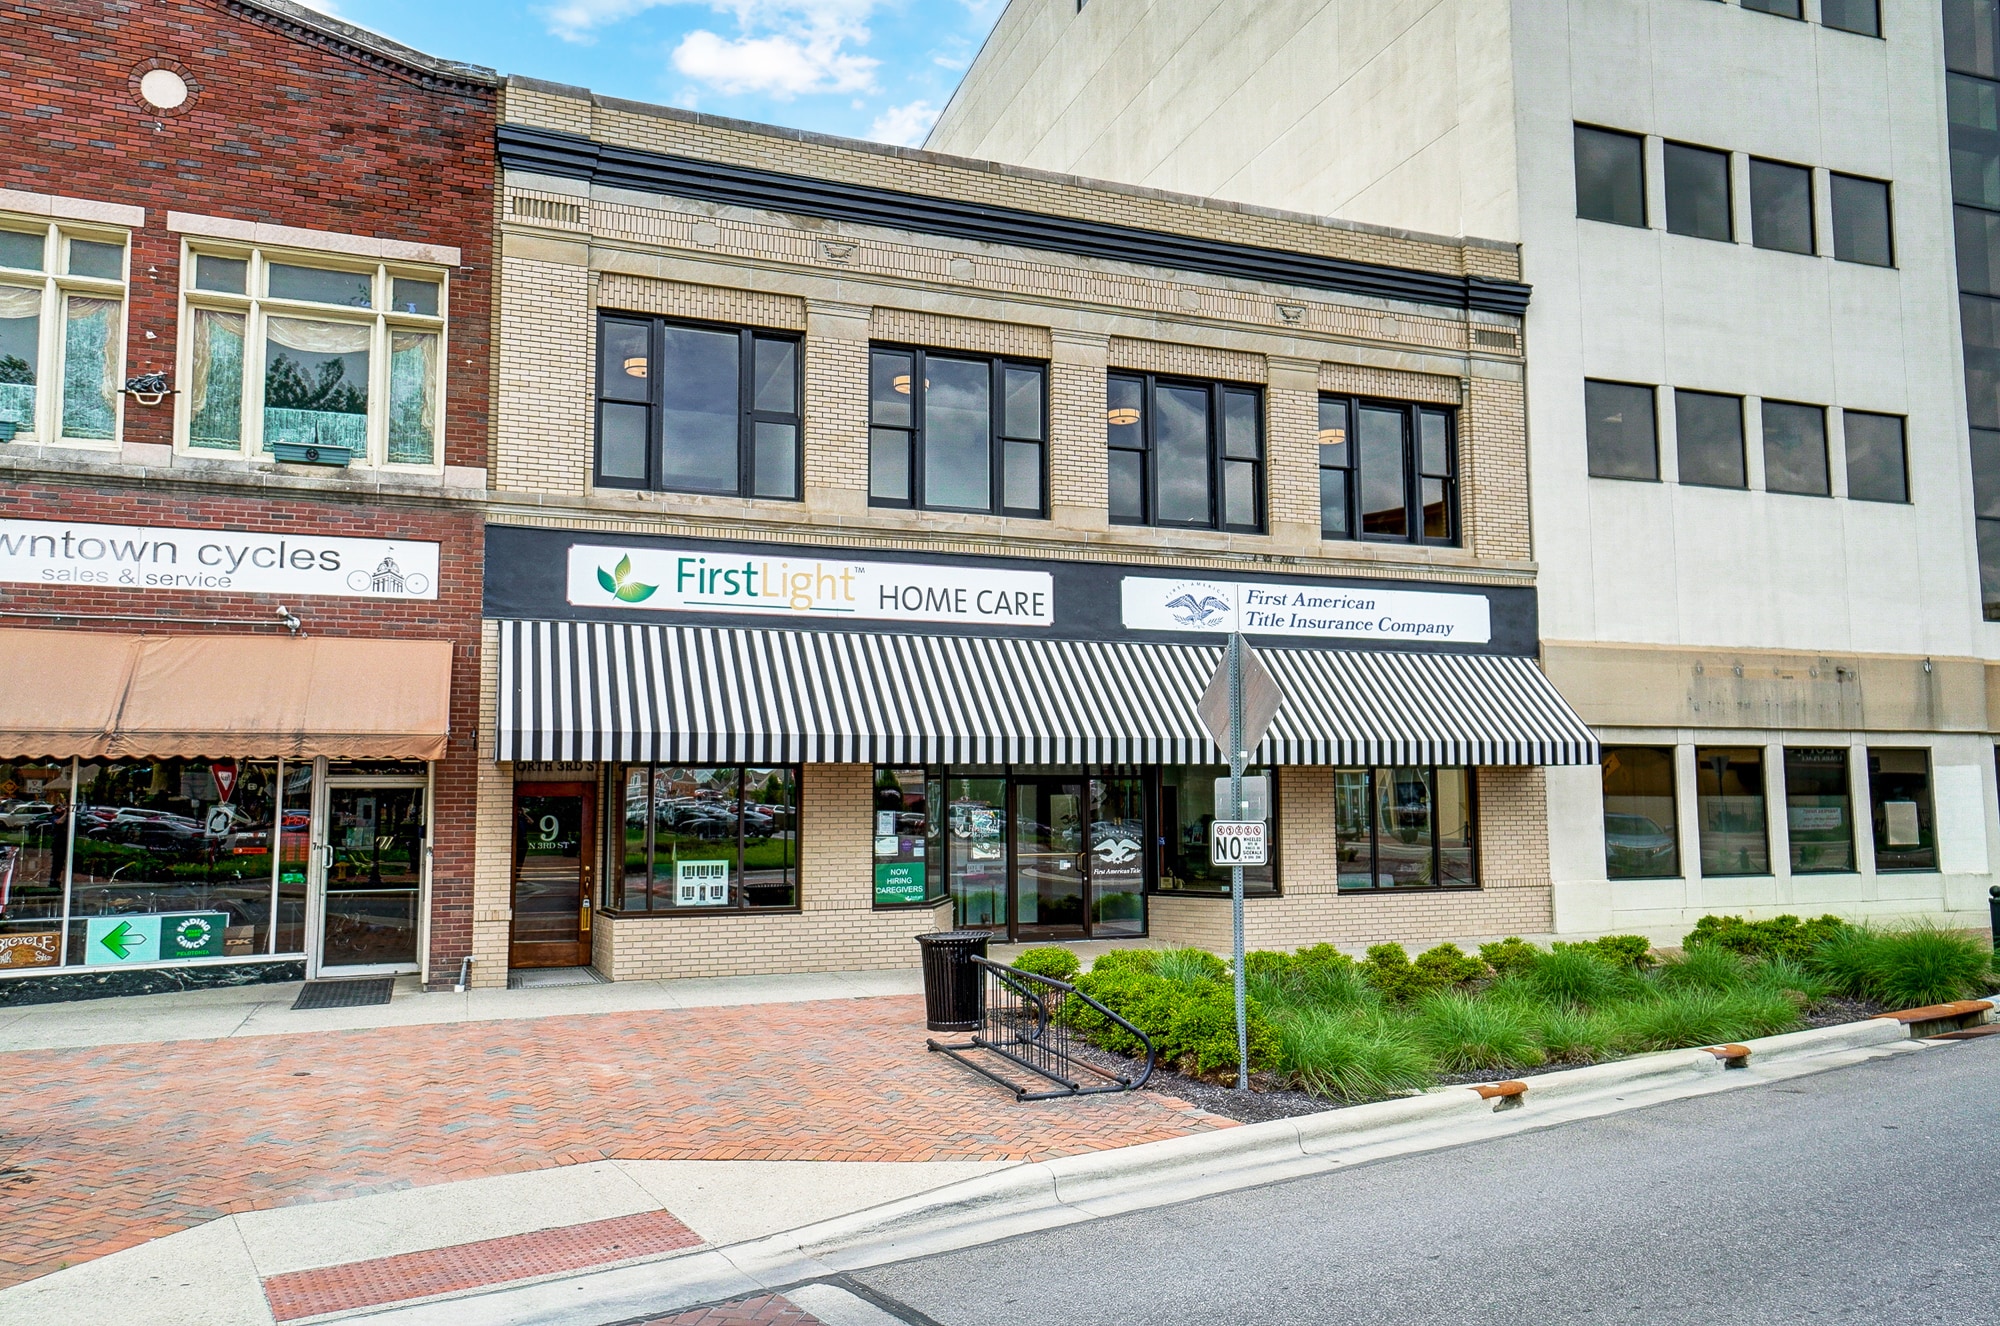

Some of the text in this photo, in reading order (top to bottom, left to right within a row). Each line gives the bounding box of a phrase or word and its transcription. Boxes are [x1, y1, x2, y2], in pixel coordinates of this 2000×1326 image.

[197, 541, 341, 575] cycles
[42, 566, 232, 589] sales & service
[879, 585, 967, 613] HOME
[976, 589, 1045, 617] CARE
[1246, 589, 1375, 610] First American
[1246, 611, 1454, 637] Title Insurance Company
[557, 761, 583, 771] 3RD
[539, 815, 559, 841] 9
[528, 841, 570, 850] N 3RD ST
[1216, 837, 1241, 860] NO
[886, 877, 913, 885] HIRING
[890, 868, 909, 876] NOW
[875, 885, 924, 894] CAREGIVERS
[177, 917, 211, 932] ENDING
[176, 933, 211, 949] CANCER
